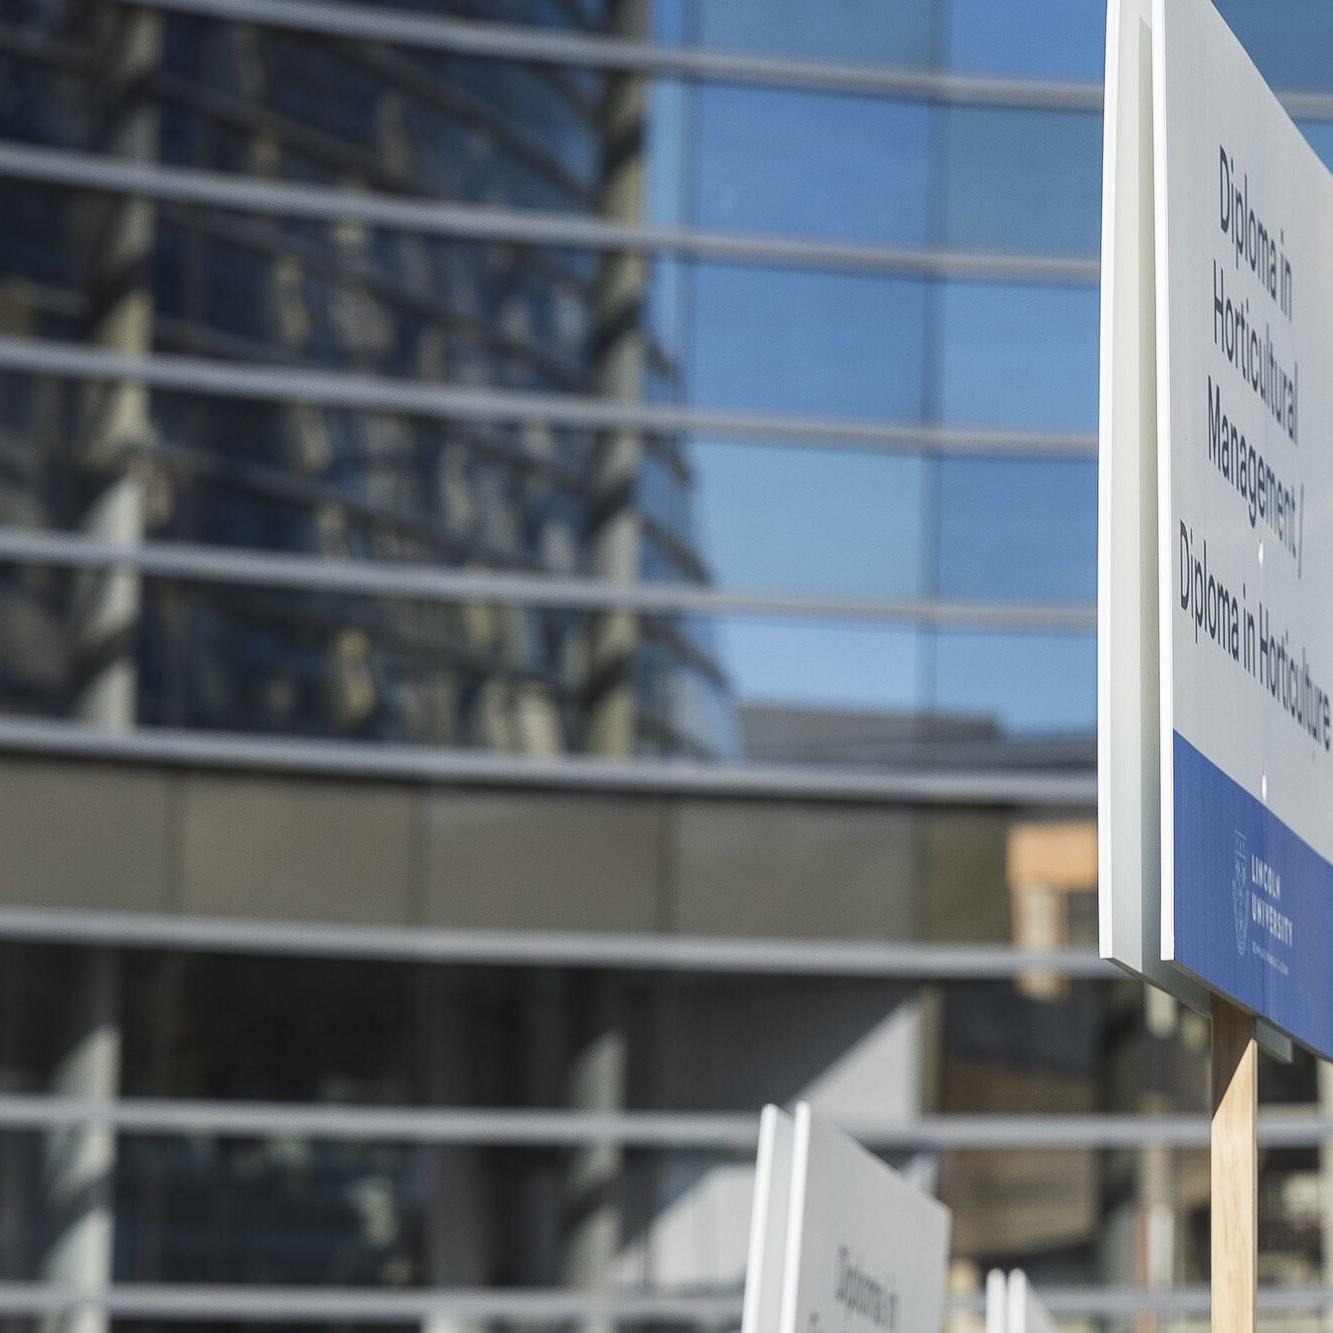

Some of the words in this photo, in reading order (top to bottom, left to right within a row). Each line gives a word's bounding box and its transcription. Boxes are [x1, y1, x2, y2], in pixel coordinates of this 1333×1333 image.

[1219, 144, 1276, 302] Diploma
[1279, 228, 1293, 322] in
[1213, 258, 1299, 447] Horticultural
[1207, 374, 1296, 560] Management
[1179, 519, 1239, 662] Diploma
[1243, 582, 1256, 678] in
[1259, 601, 1332, 752] Horticulture
[1251, 853, 1281, 901] LINCOLN
[1251, 892, 1294, 949] UNIVERSITY
